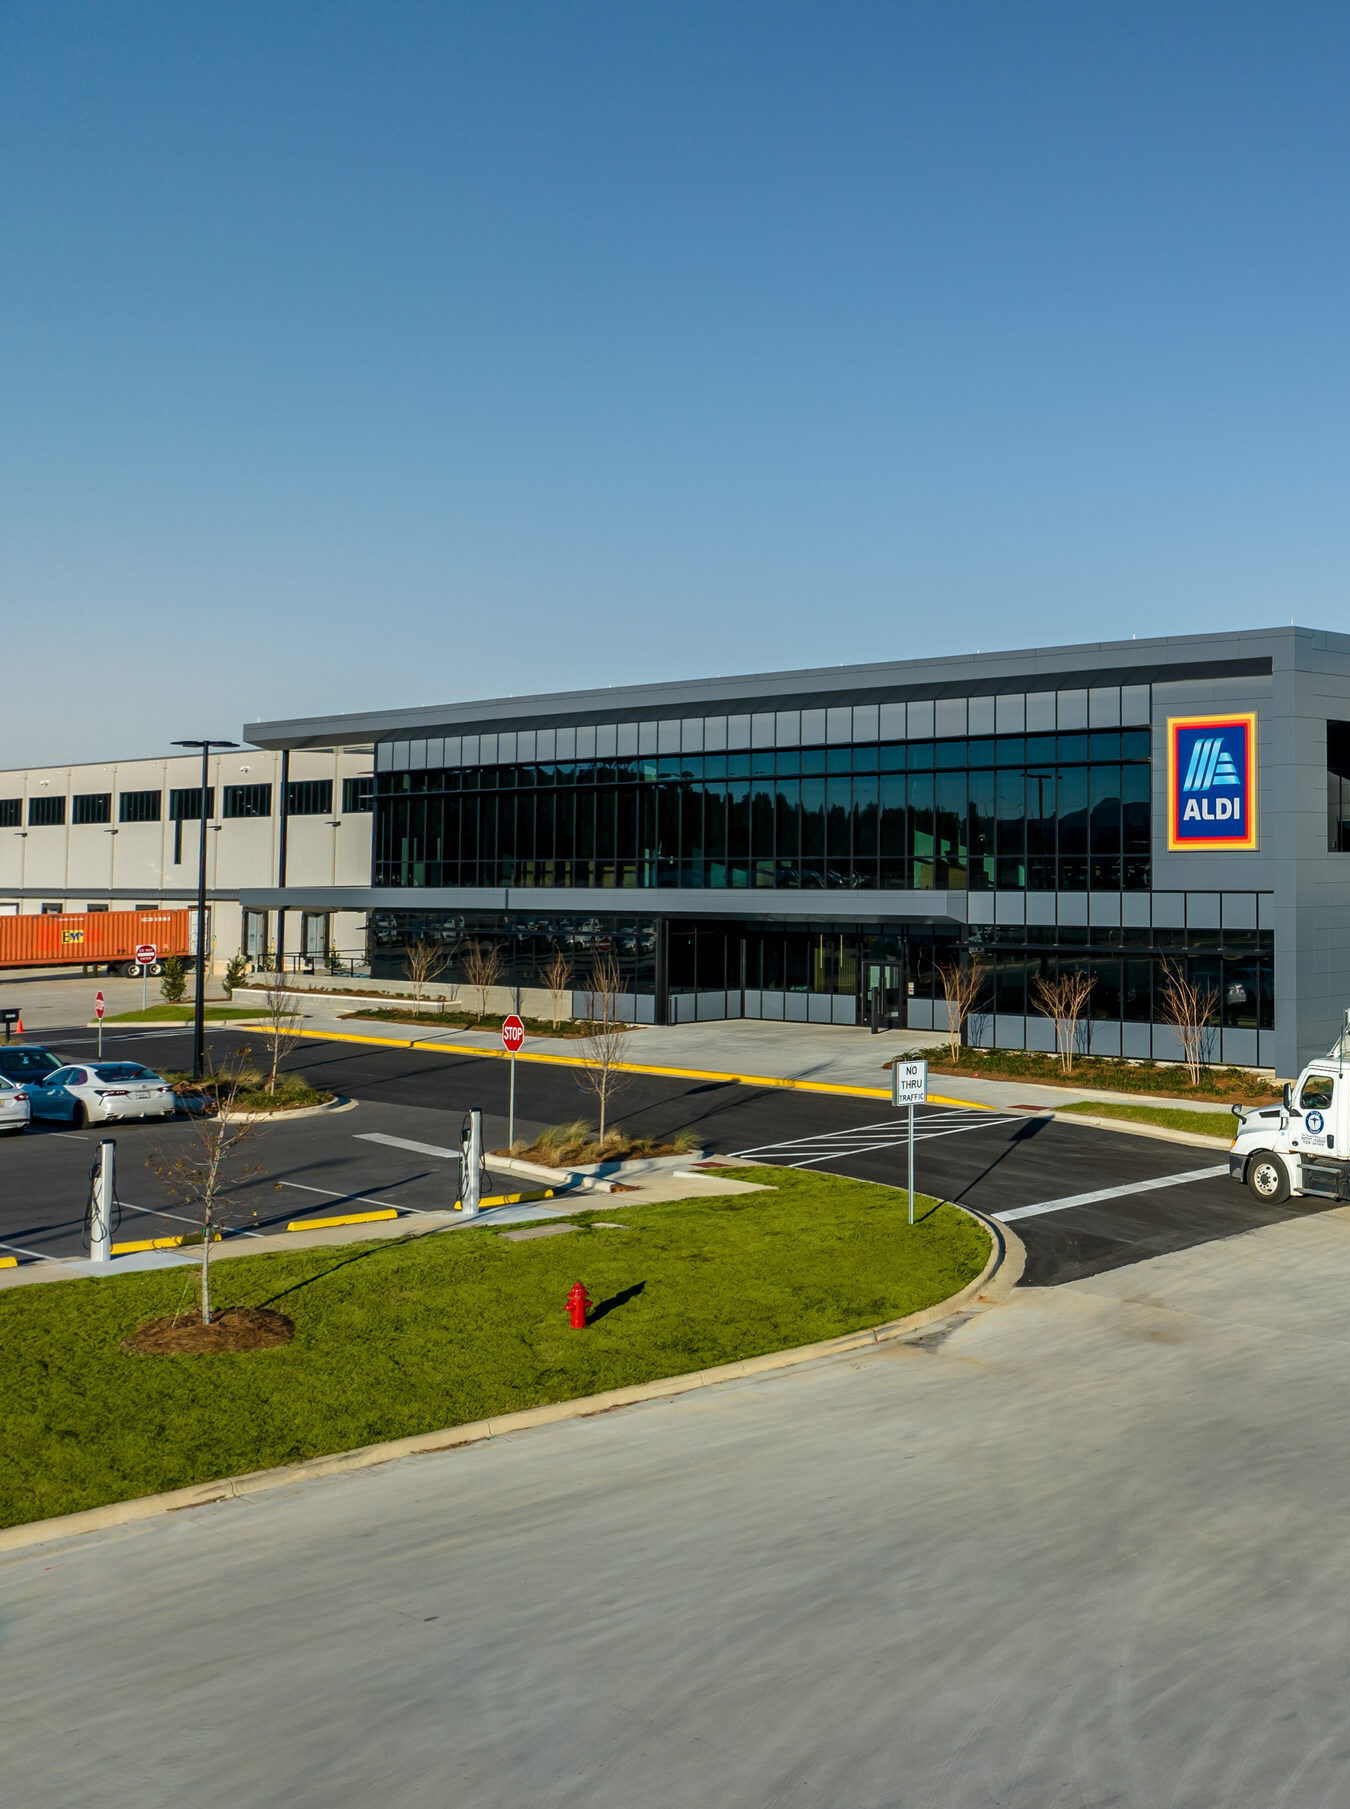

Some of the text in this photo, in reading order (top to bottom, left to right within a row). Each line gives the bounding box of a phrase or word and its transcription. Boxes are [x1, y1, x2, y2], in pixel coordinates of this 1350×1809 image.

[1183, 797, 1240, 821] ALDI
[503, 1026, 523, 1041] STOP
[906, 1065, 918, 1075] NO
[901, 1079, 922, 1090] THRU
[899, 1092, 924, 1102] TRAFFIC
